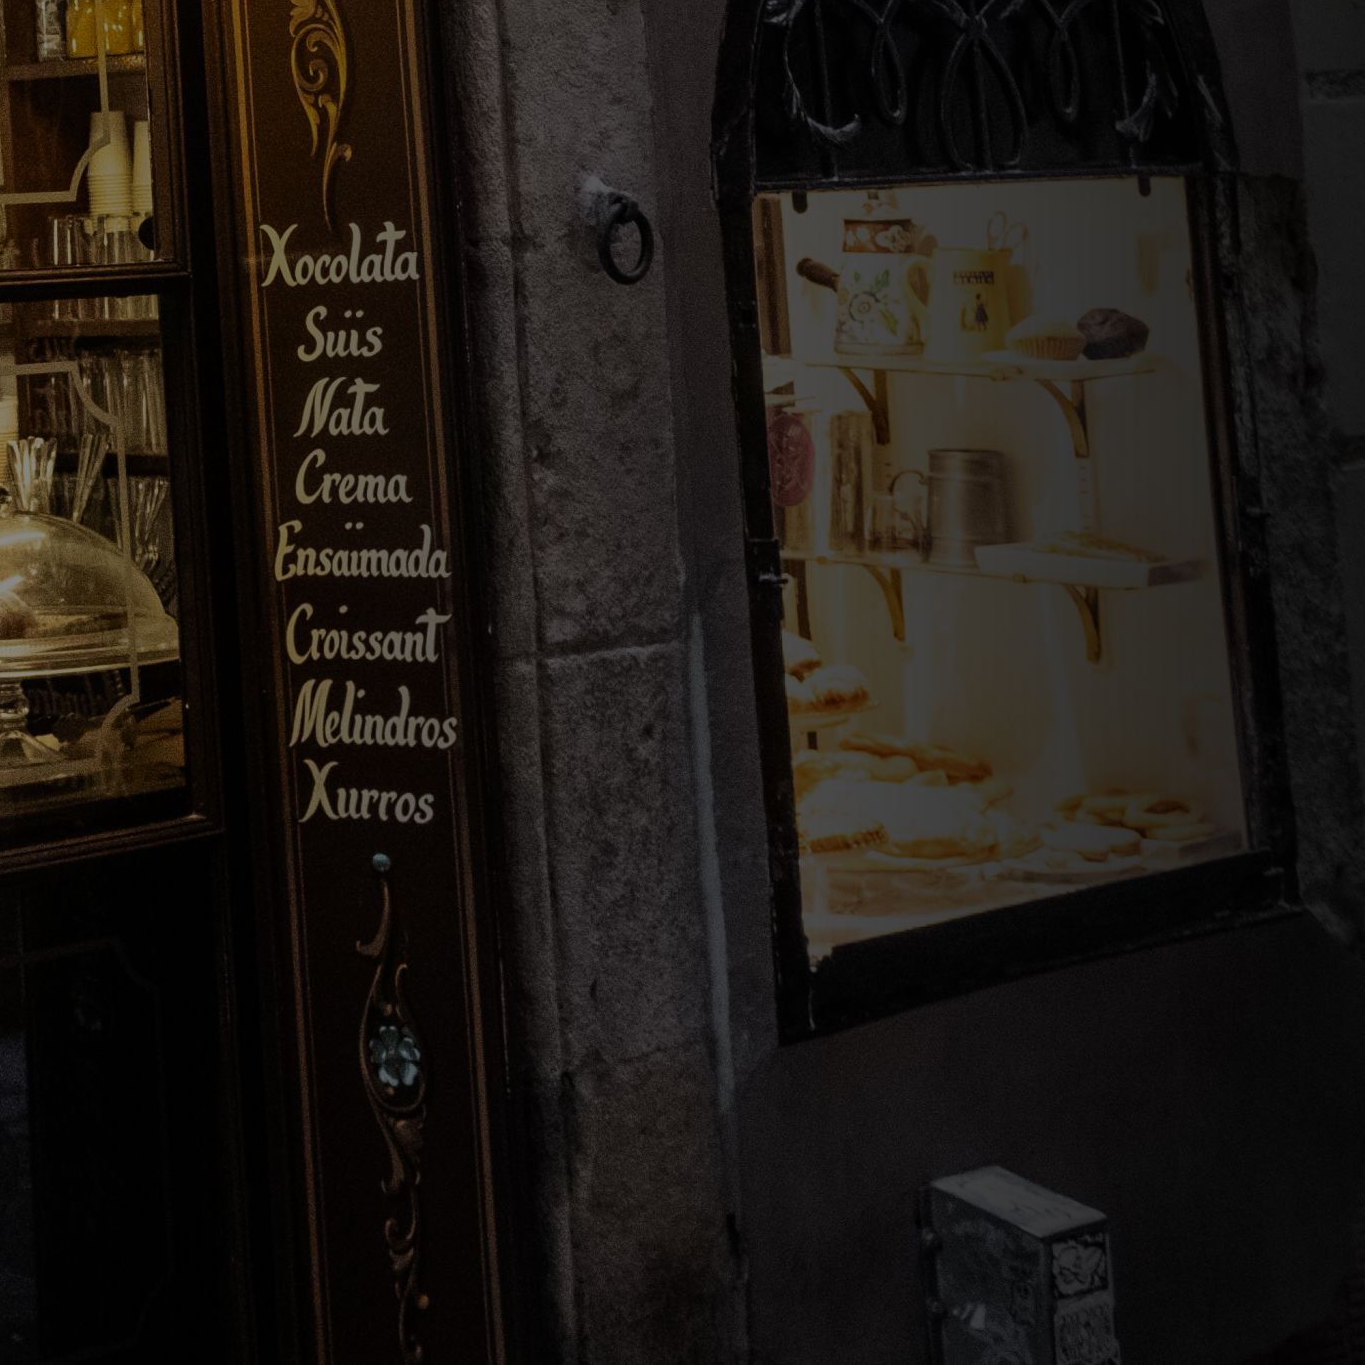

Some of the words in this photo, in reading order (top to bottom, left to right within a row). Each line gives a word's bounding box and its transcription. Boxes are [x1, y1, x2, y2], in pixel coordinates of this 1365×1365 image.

[259, 220, 420, 287] Xocolata
[297, 305, 383, 363] Suïs
[292, 376, 390, 439] Nata
[295, 448, 414, 505] Crema
[274, 519, 453, 582] Ensaïmada
[285, 602, 453, 665] Croissant
[288, 678, 459, 750] Melindros
[297, 758, 436, 825] Xurros
